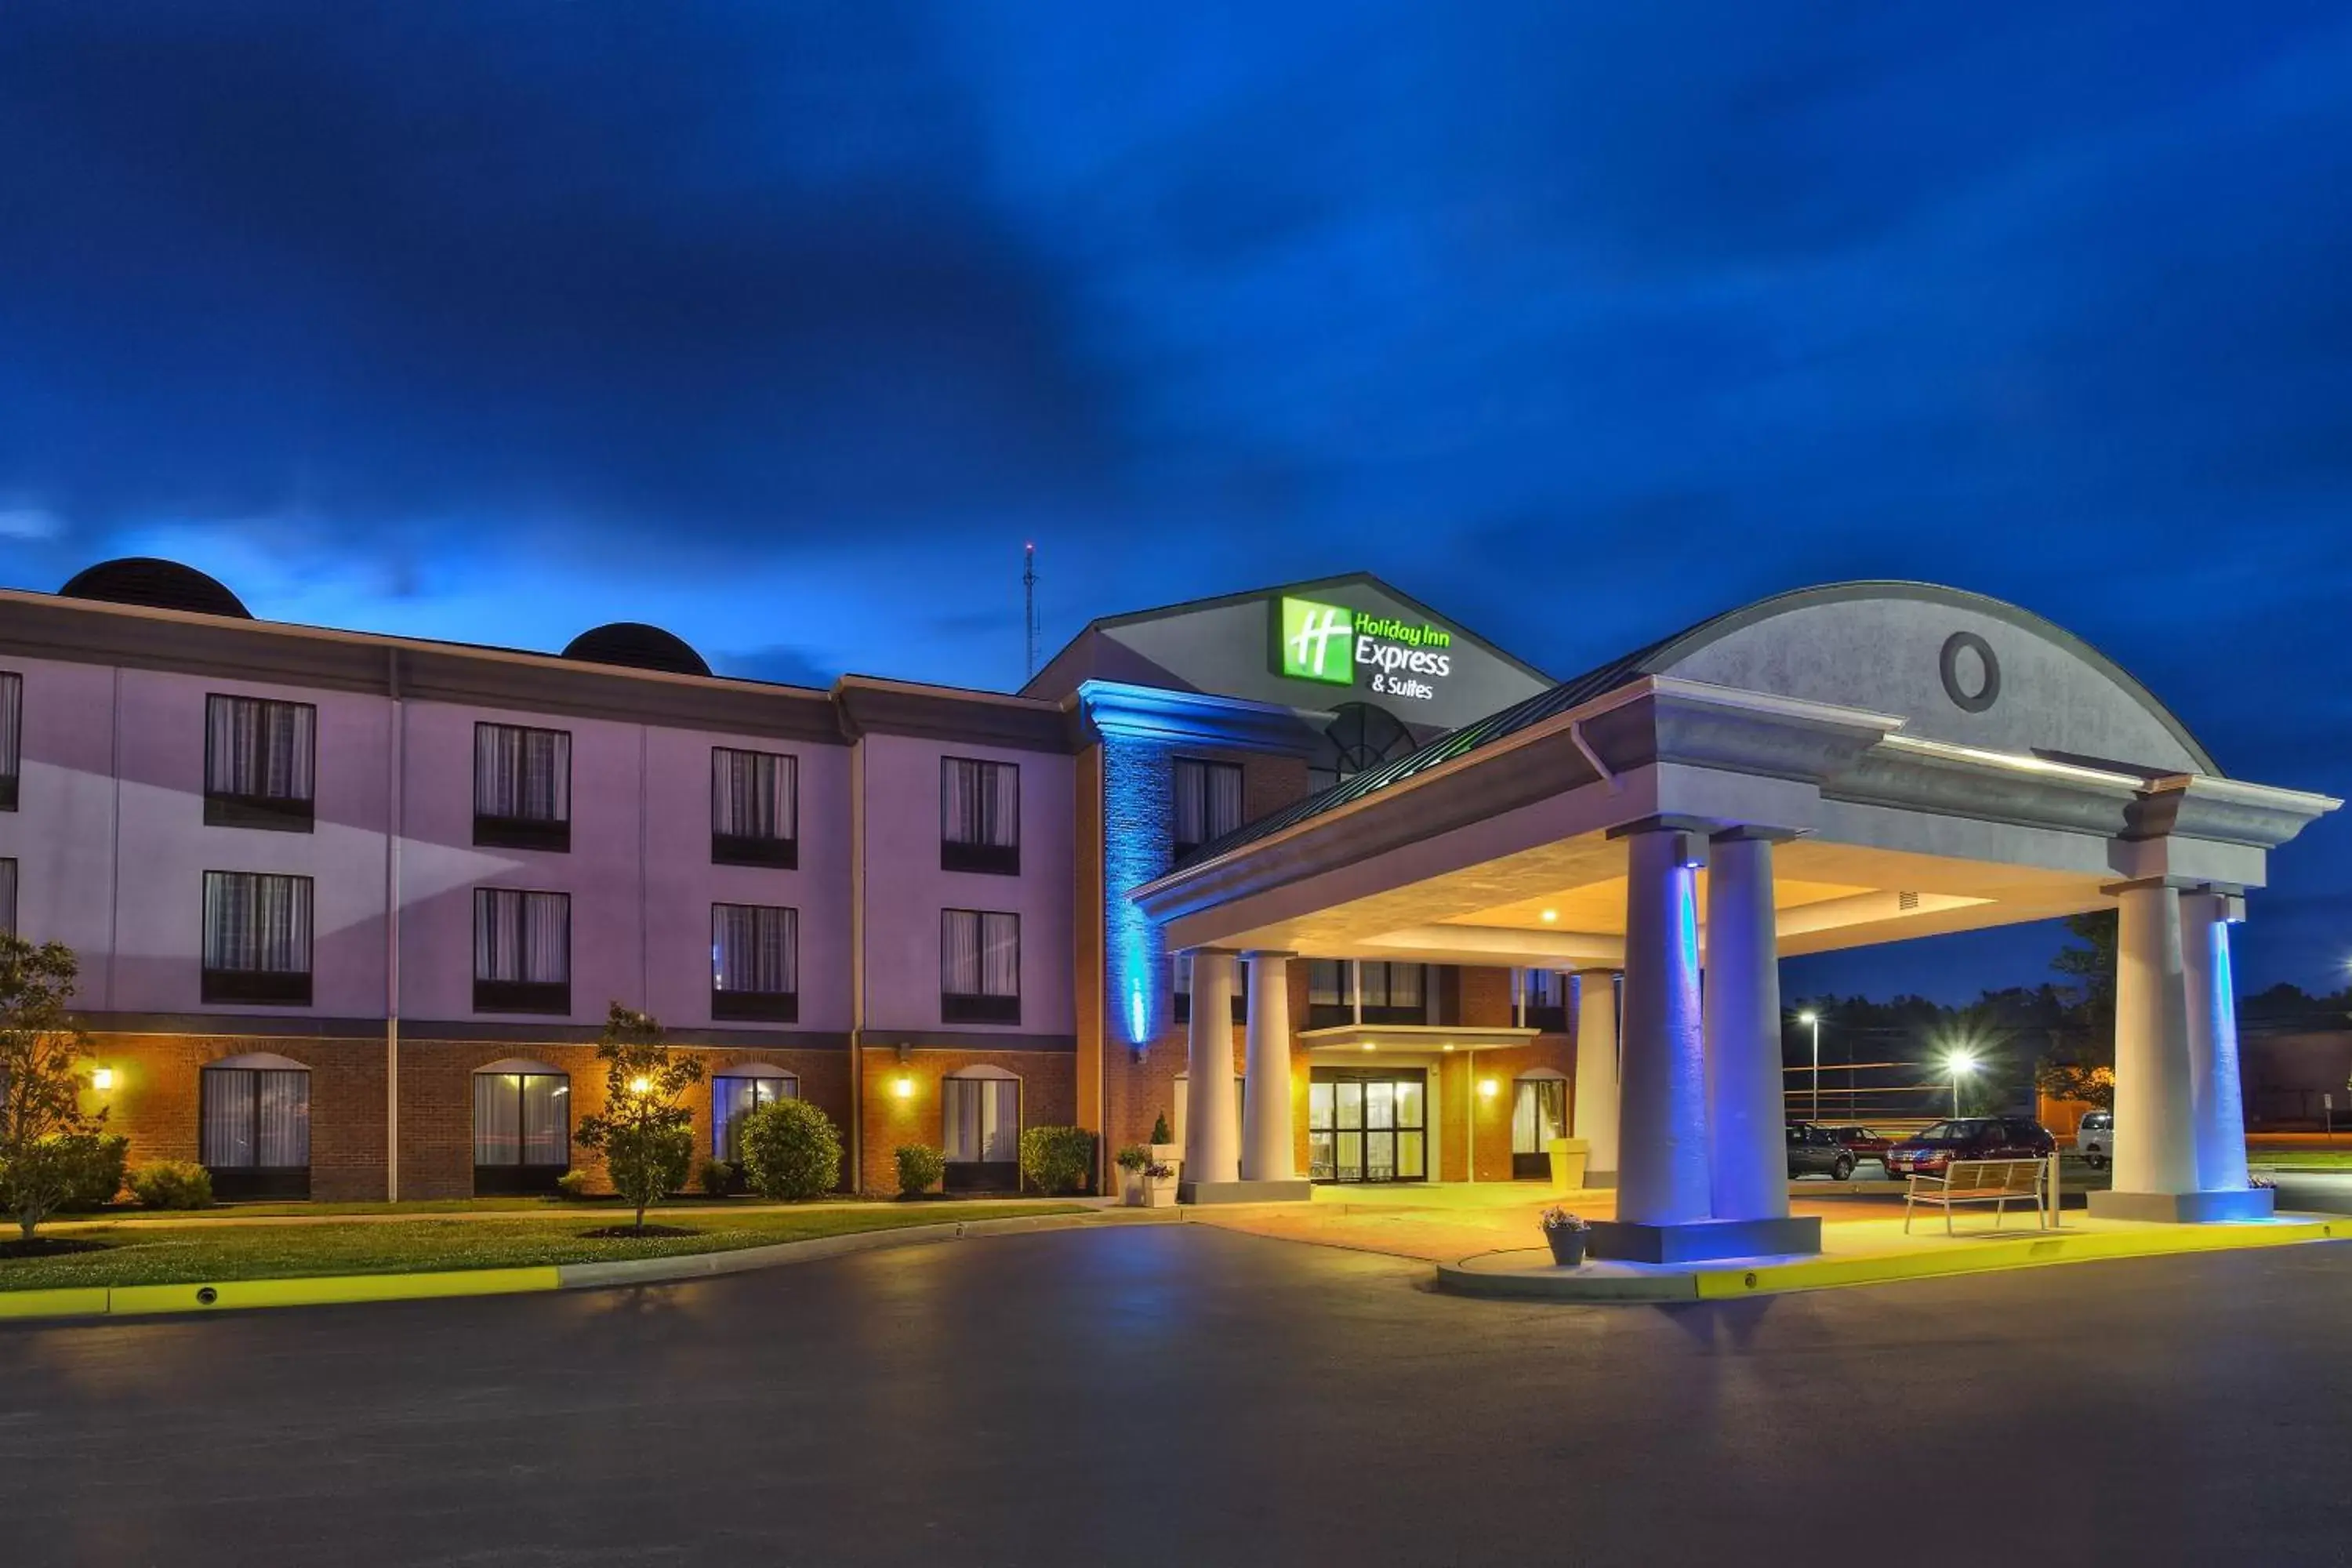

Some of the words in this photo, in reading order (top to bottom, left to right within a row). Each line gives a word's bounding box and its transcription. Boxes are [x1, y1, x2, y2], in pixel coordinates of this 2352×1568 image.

[1355, 612, 1421, 647] Holiday
[1423, 626, 1450, 647] Inn
[1356, 636, 1450, 677] Express
[1372, 673, 1385, 692] &
[1387, 677, 1433, 699] Suites
